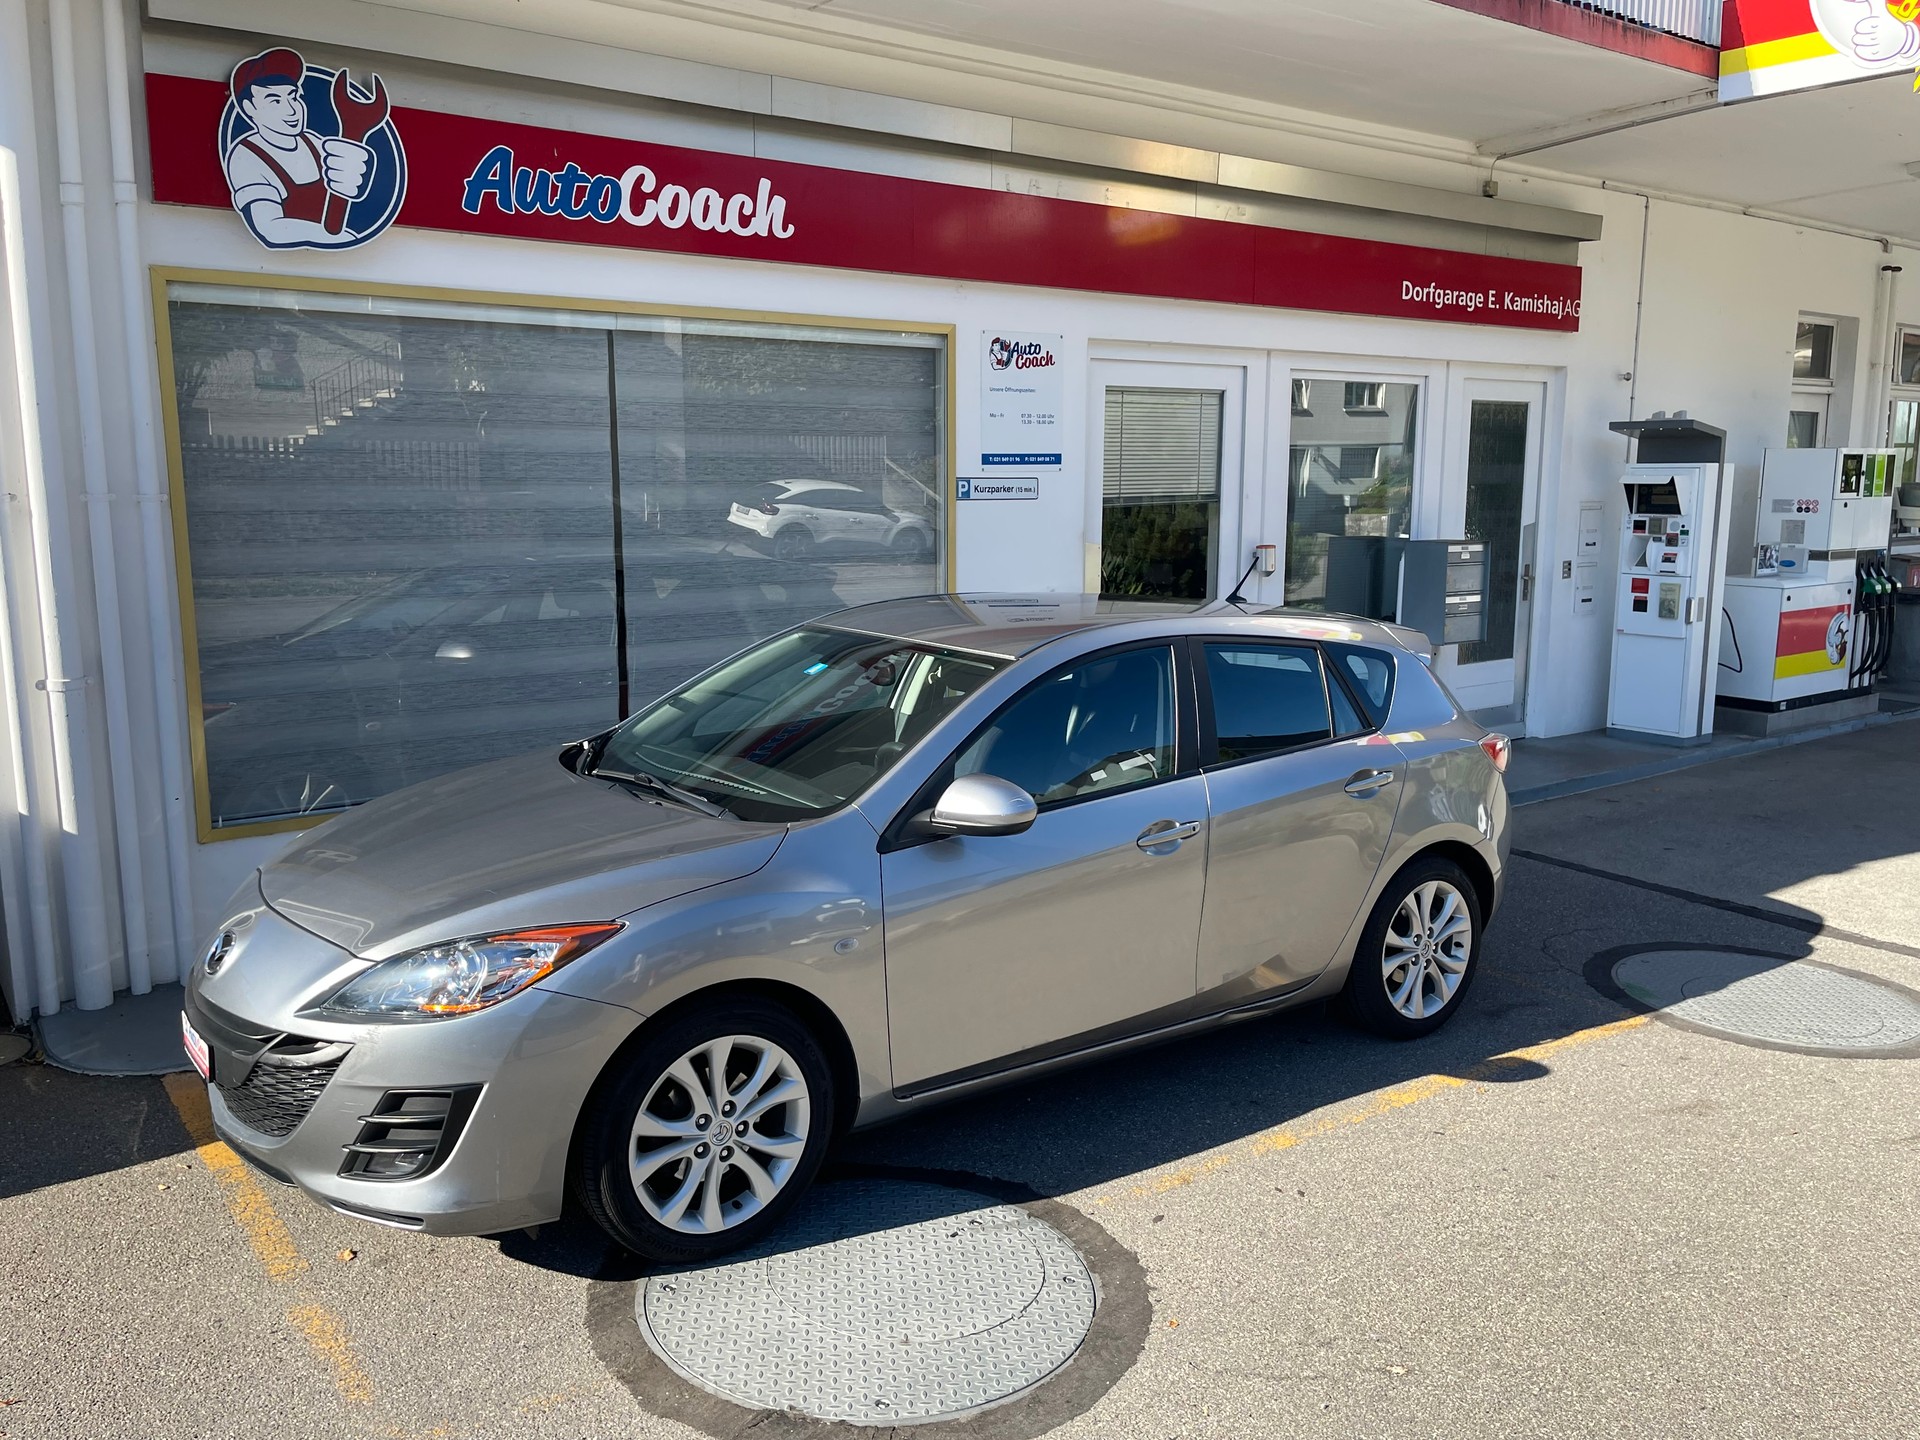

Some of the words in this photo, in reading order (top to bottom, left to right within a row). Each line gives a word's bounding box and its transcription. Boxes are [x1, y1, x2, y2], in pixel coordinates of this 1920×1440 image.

[1402, 280, 1484, 312] Dorfgarage
[1488, 290, 1499, 309] E.
[1011, 341, 1041, 358] Auto
[1015, 350, 1056, 370] Coach
[974, 485, 1014, 495] Kurzparker
[1015, 486, 1023, 494] (15
[1850, 475, 1857, 490] 1
